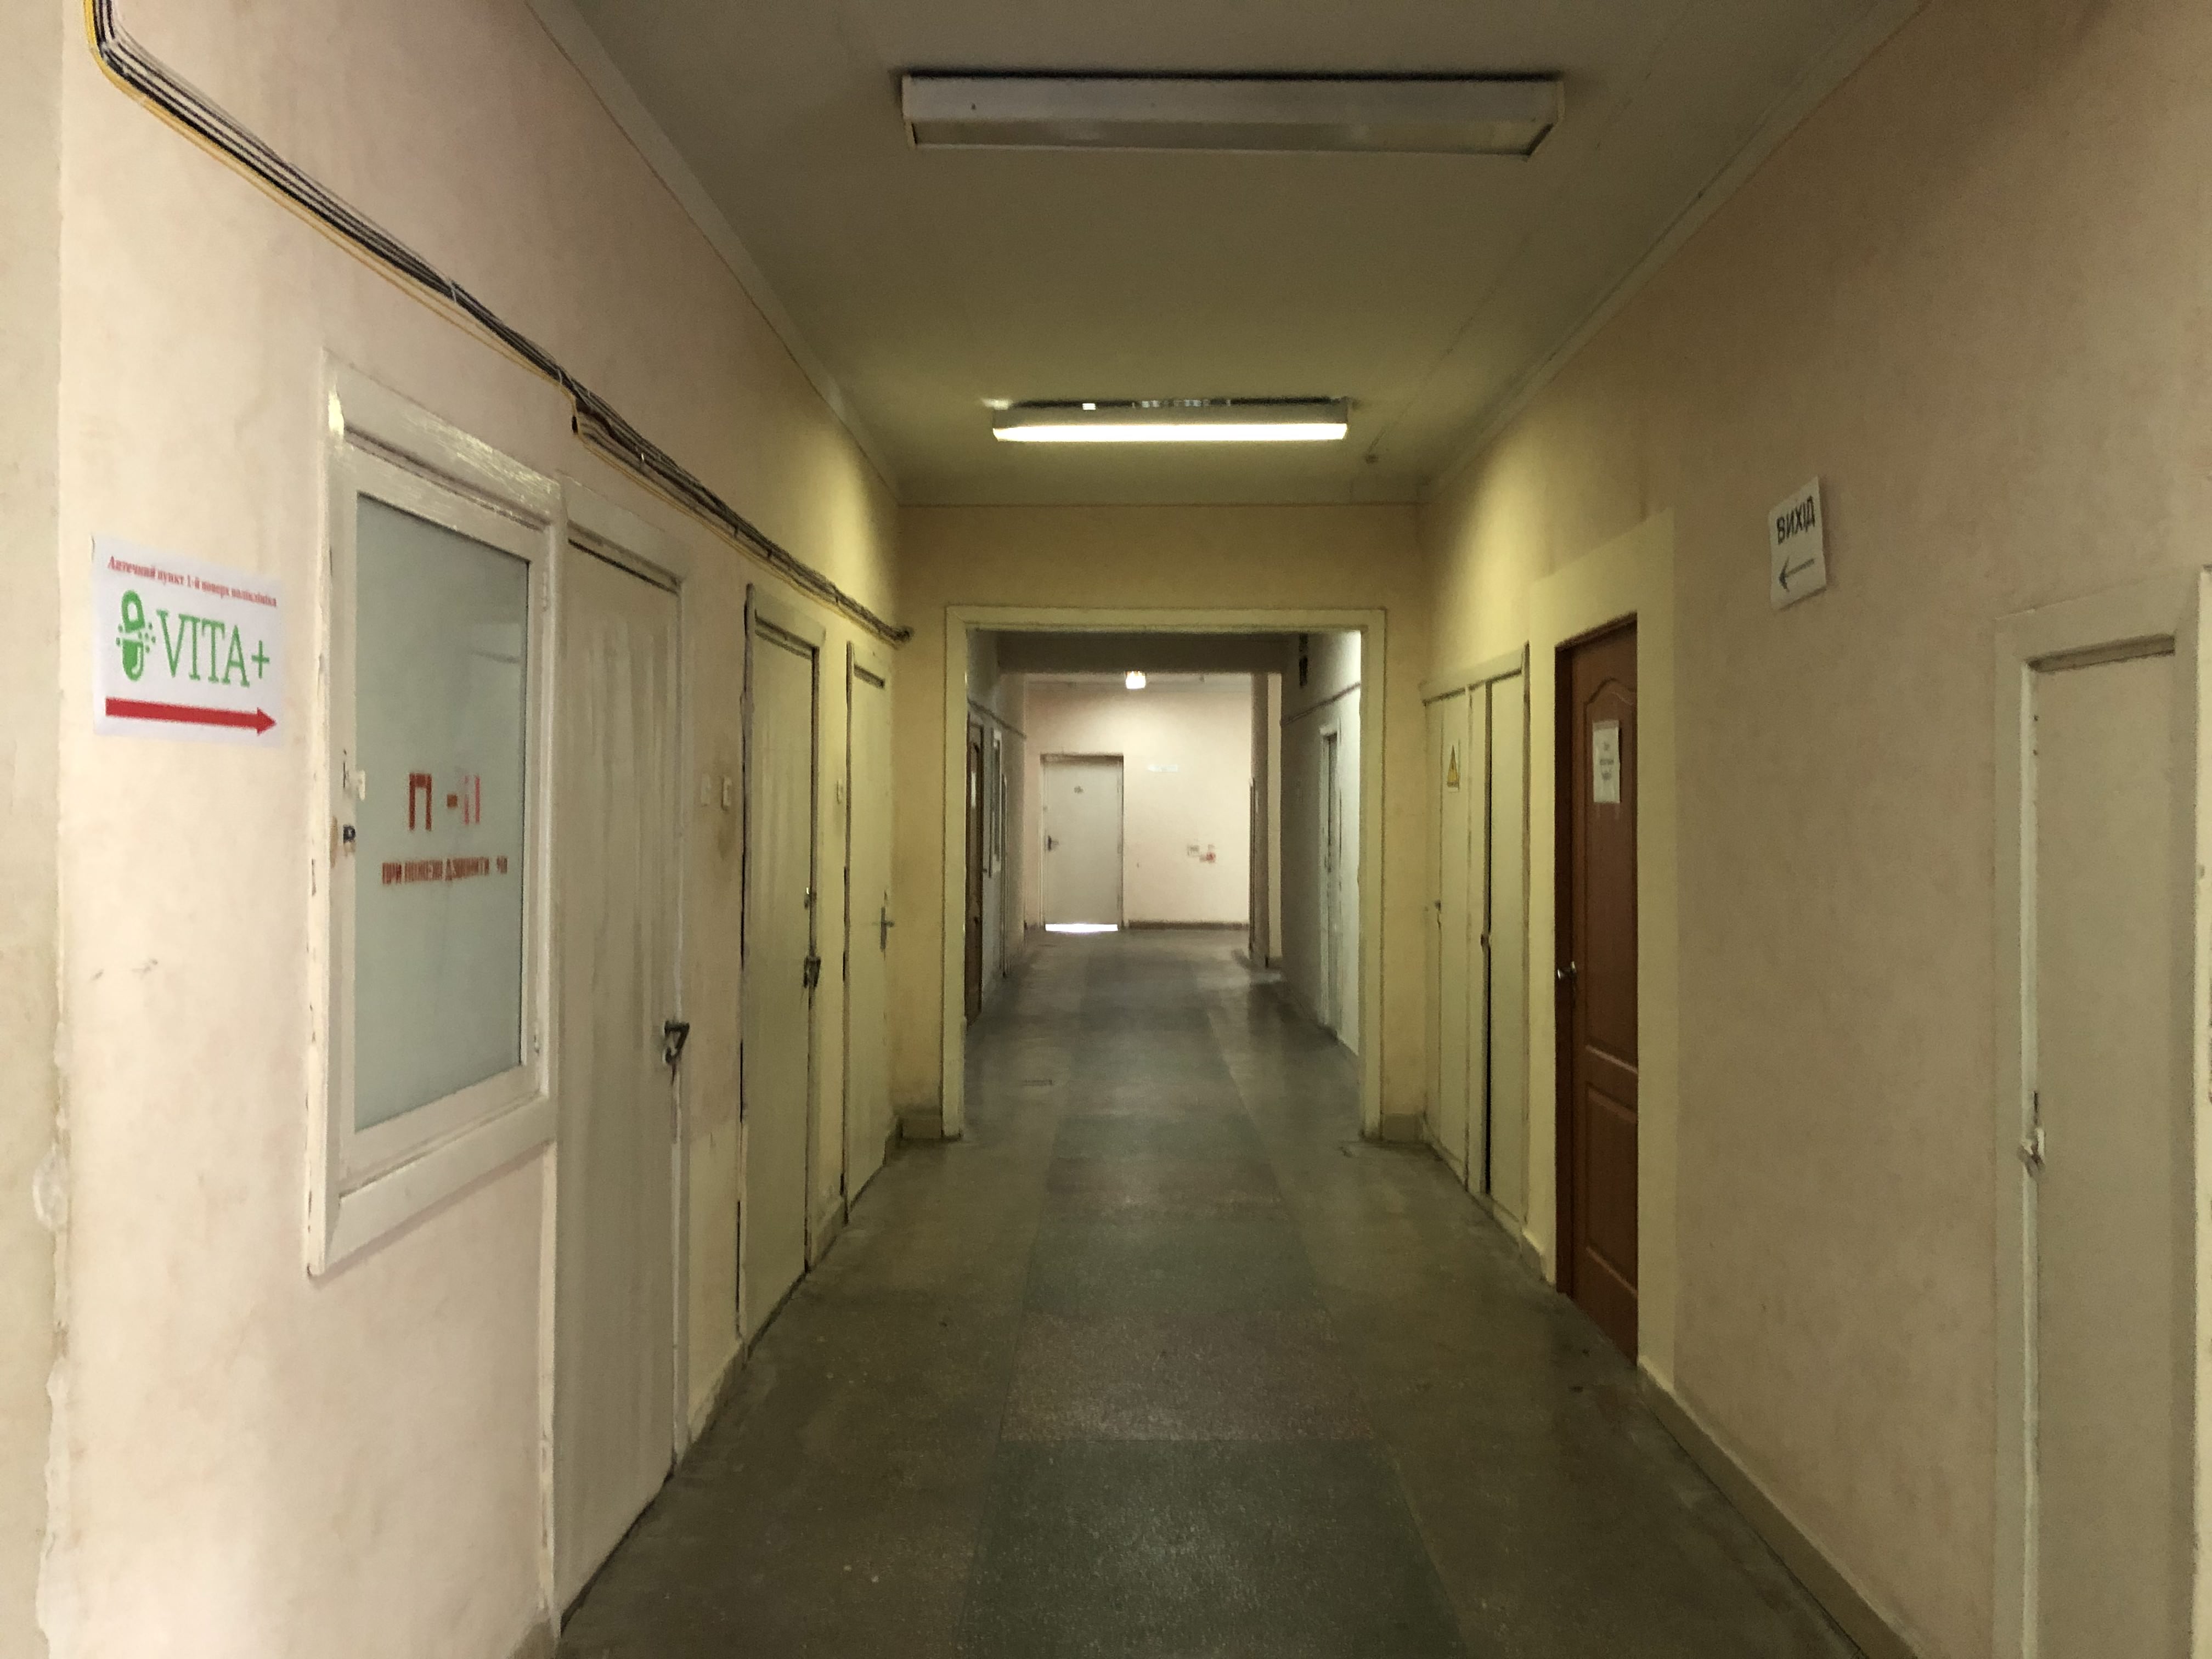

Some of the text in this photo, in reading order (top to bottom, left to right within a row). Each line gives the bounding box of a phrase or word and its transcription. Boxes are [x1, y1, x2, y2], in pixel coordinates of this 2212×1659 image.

[1776, 496, 1815, 545] ВИХІД
[157, 570, 184, 585] пункт
[156, 608, 270, 688] VITA+
